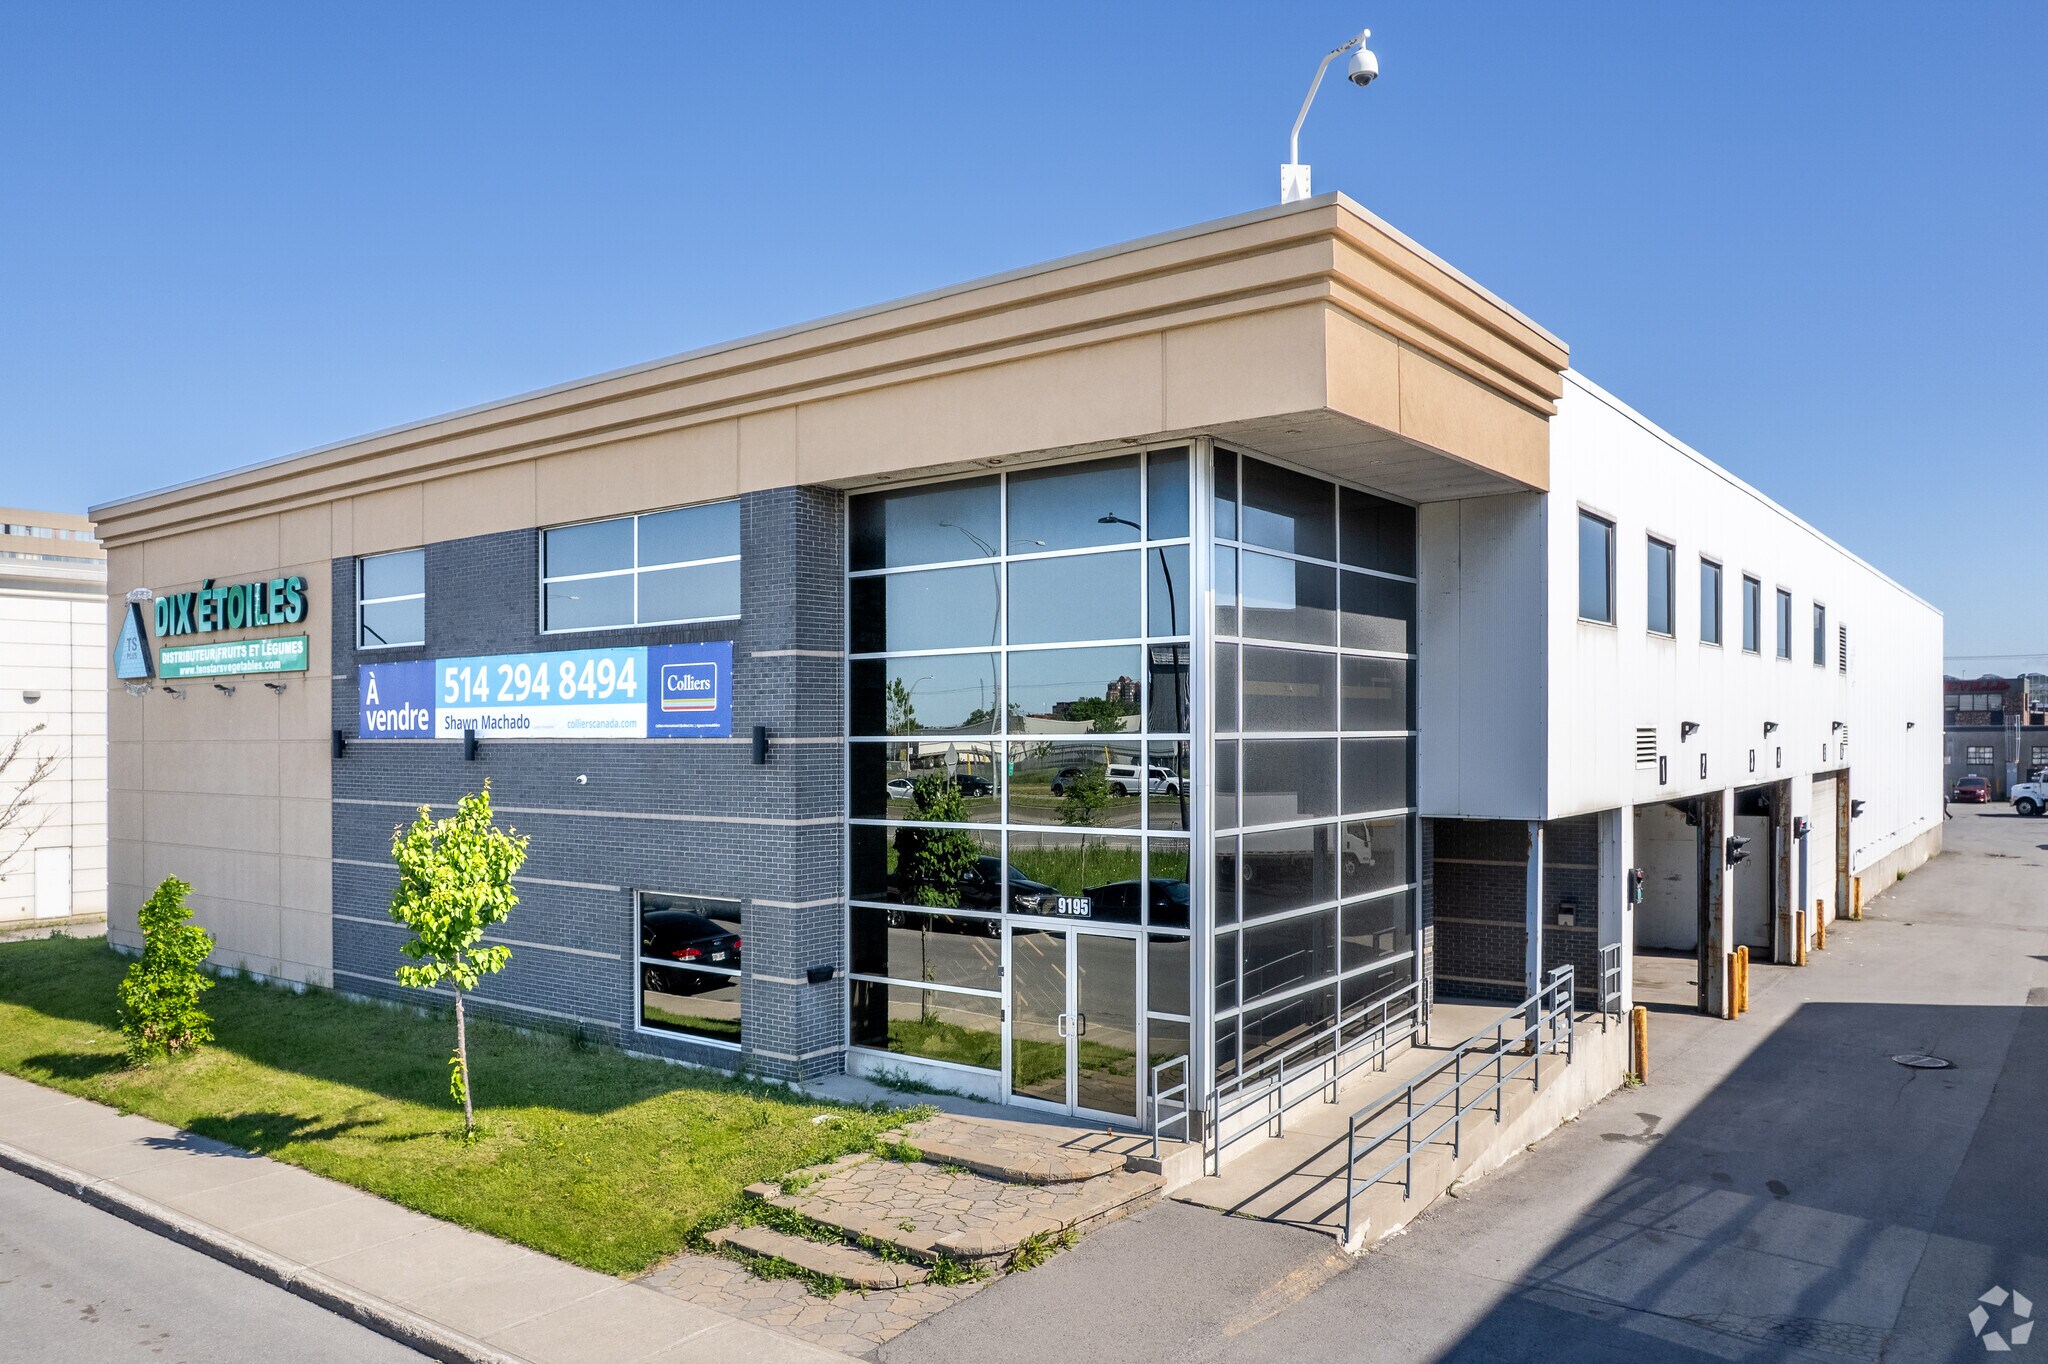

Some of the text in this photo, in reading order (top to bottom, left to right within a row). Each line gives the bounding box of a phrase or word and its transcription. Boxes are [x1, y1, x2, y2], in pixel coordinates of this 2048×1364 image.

[155, 576, 307, 637] DIX ÉTOILES
[126, 638, 138, 652] TS
[249, 643, 260, 657] ET
[261, 640, 303, 656] LÉGUMES
[366, 671, 379, 705] À
[444, 657, 637, 703] 514 294 8494
[667, 674, 711, 692] Colliers
[366, 702, 429, 731] vendre
[444, 713, 530, 730] Shawn Machado
[567, 718, 637, 729] collierscanada.com
[1058, 897, 1088, 915] 9195
